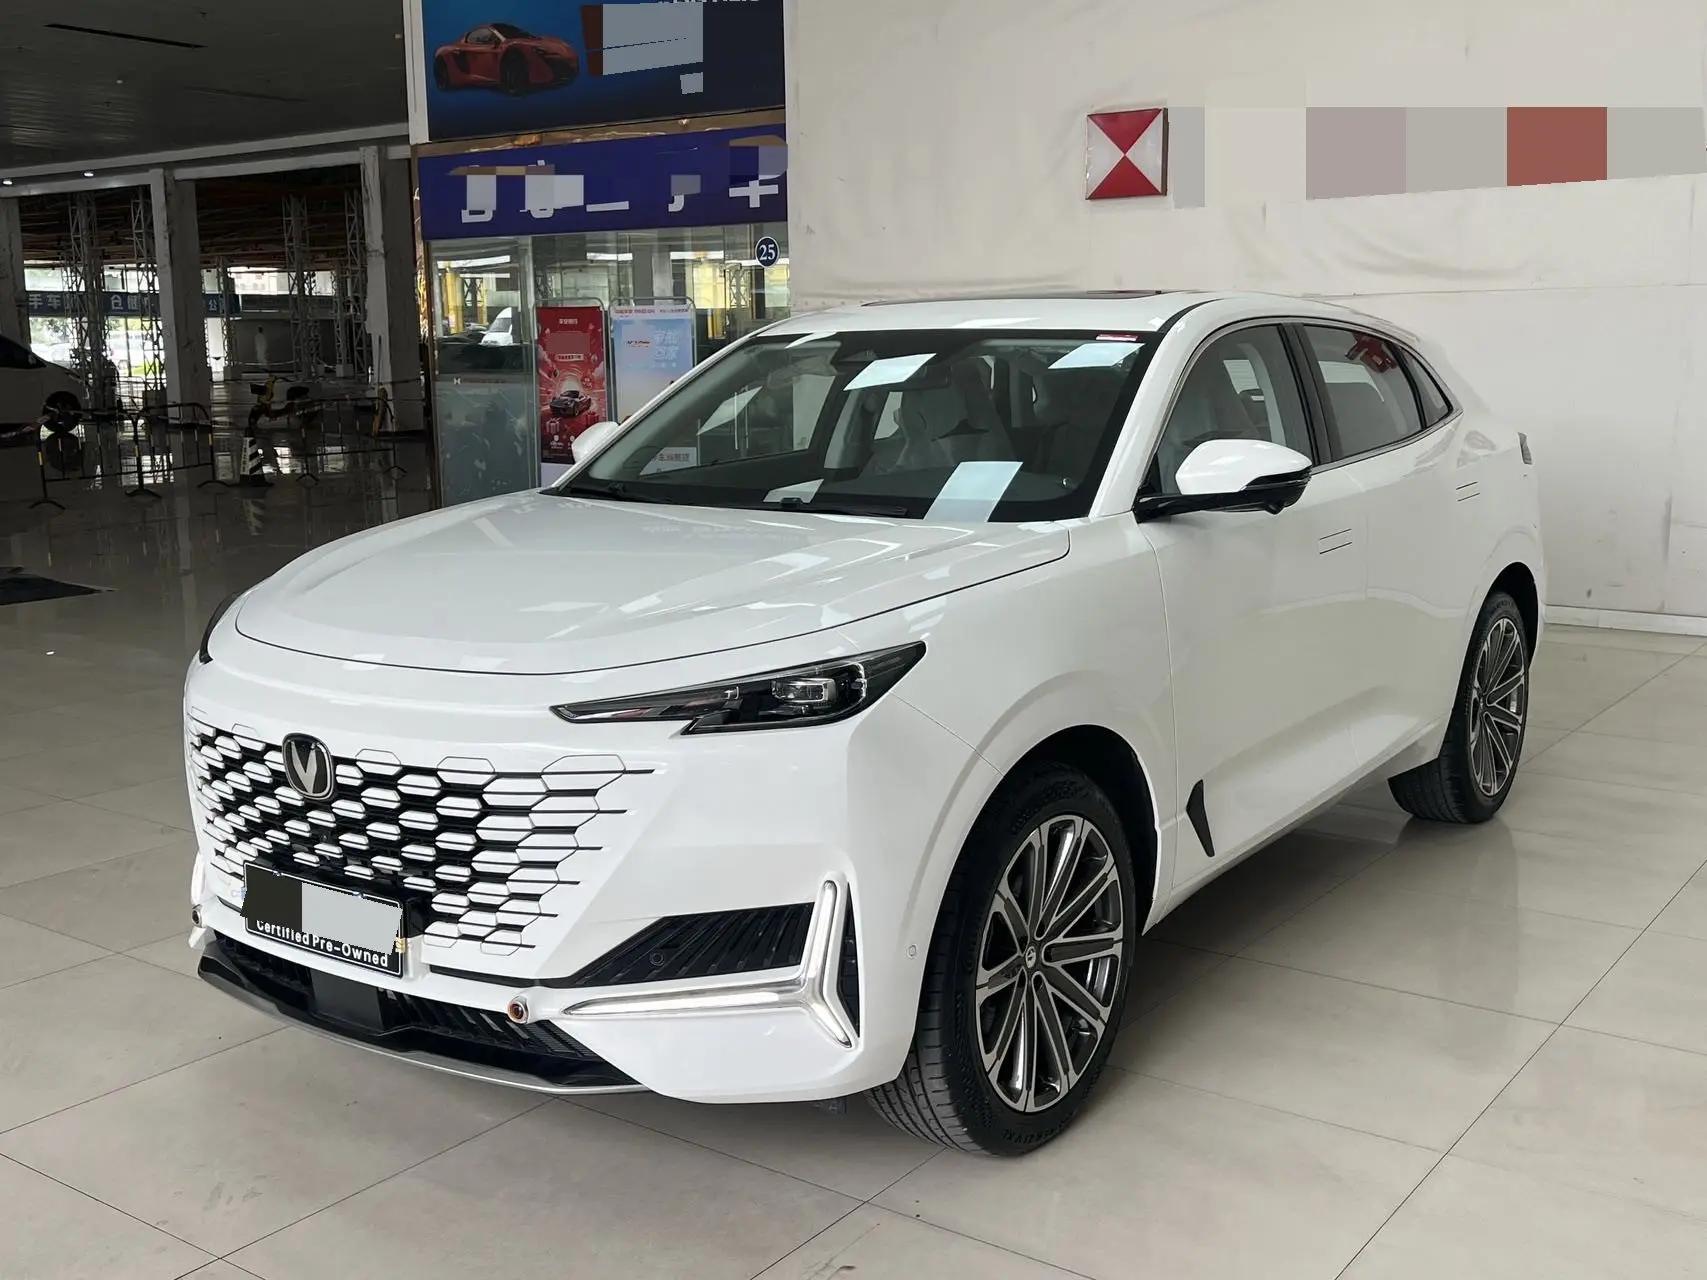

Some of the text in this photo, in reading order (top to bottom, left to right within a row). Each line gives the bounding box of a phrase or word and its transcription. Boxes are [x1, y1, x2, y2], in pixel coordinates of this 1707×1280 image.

[759, 244, 776, 260] 25
[256, 920, 389, 968] Certified Pre-Owned
